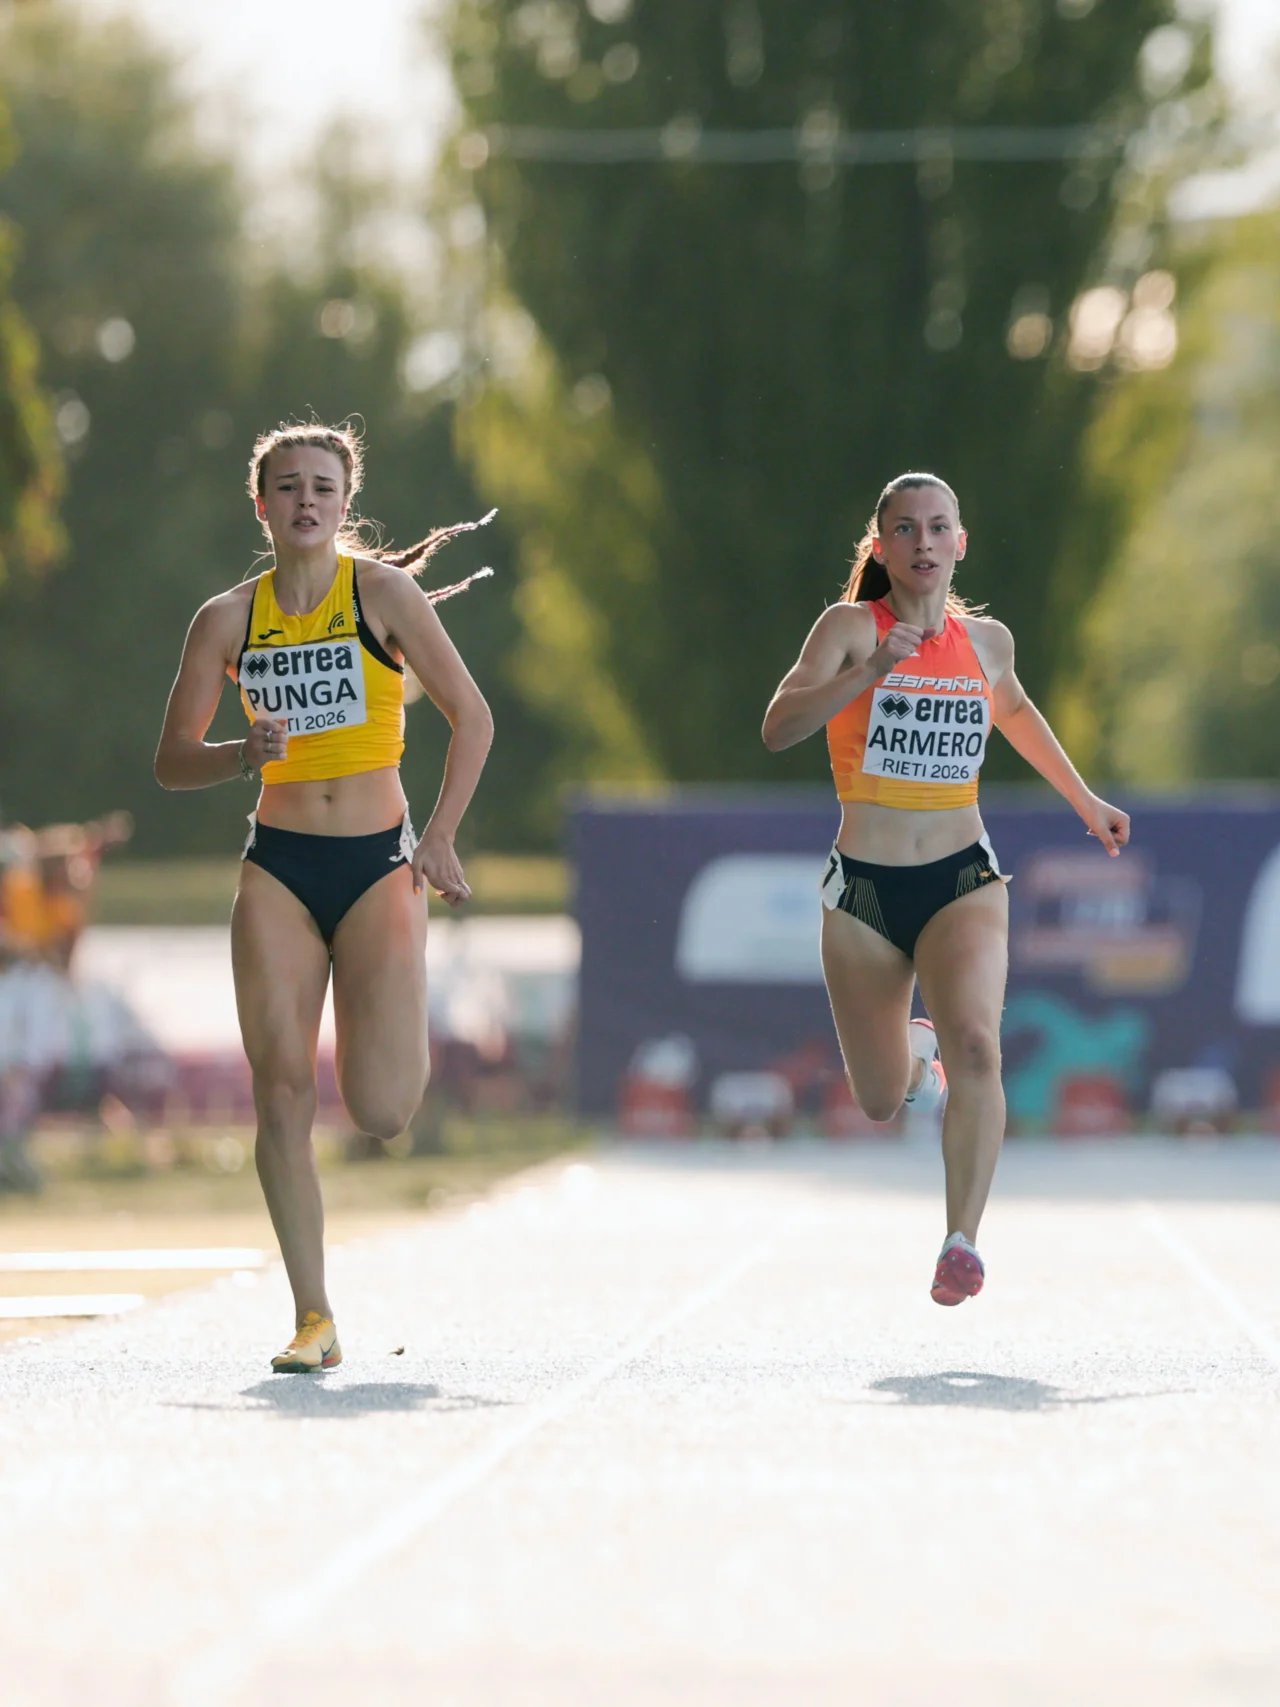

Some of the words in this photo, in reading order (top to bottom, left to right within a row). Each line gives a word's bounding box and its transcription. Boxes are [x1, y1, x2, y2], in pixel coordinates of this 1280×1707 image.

[882, 672, 983, 693] ESPAÑA
[246, 677, 358, 713] PUNGA
[304, 709, 347, 731] 2026
[867, 724, 983, 758] ARMERO
[882, 757, 927, 778] RIETI
[930, 763, 970, 780] 2026
